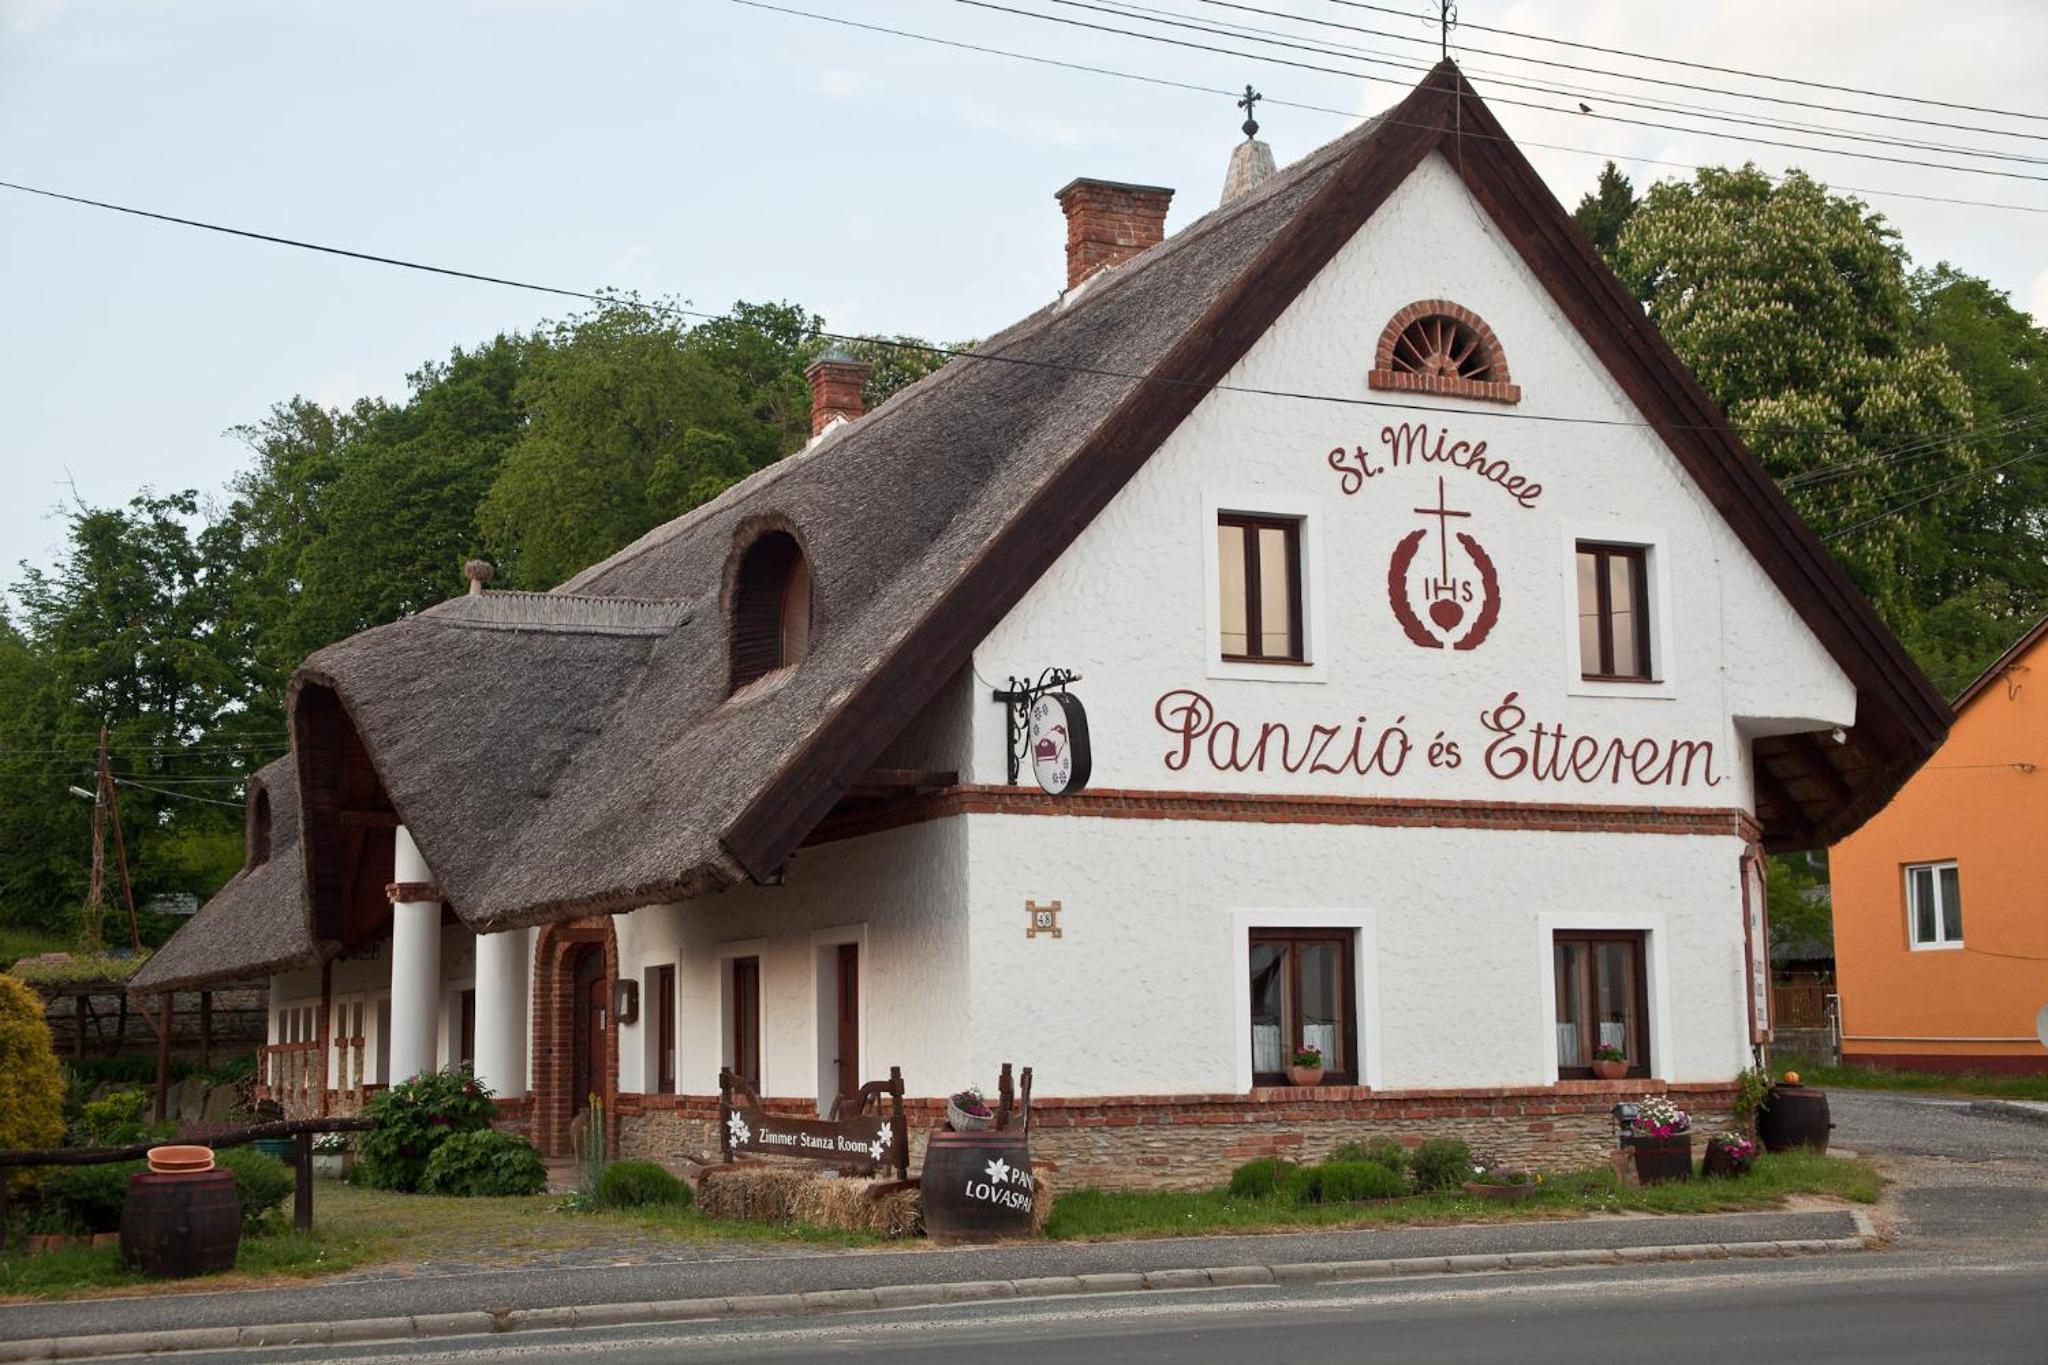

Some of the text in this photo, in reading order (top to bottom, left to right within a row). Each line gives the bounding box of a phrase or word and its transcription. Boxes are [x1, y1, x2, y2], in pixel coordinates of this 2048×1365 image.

[1328, 422, 1543, 508] St. Michael
[1425, 577, 1474, 602] IHS
[1155, 689, 1721, 786] Panzió és Étterem
[759, 1128, 868, 1153] Zimmer Stanza Room
